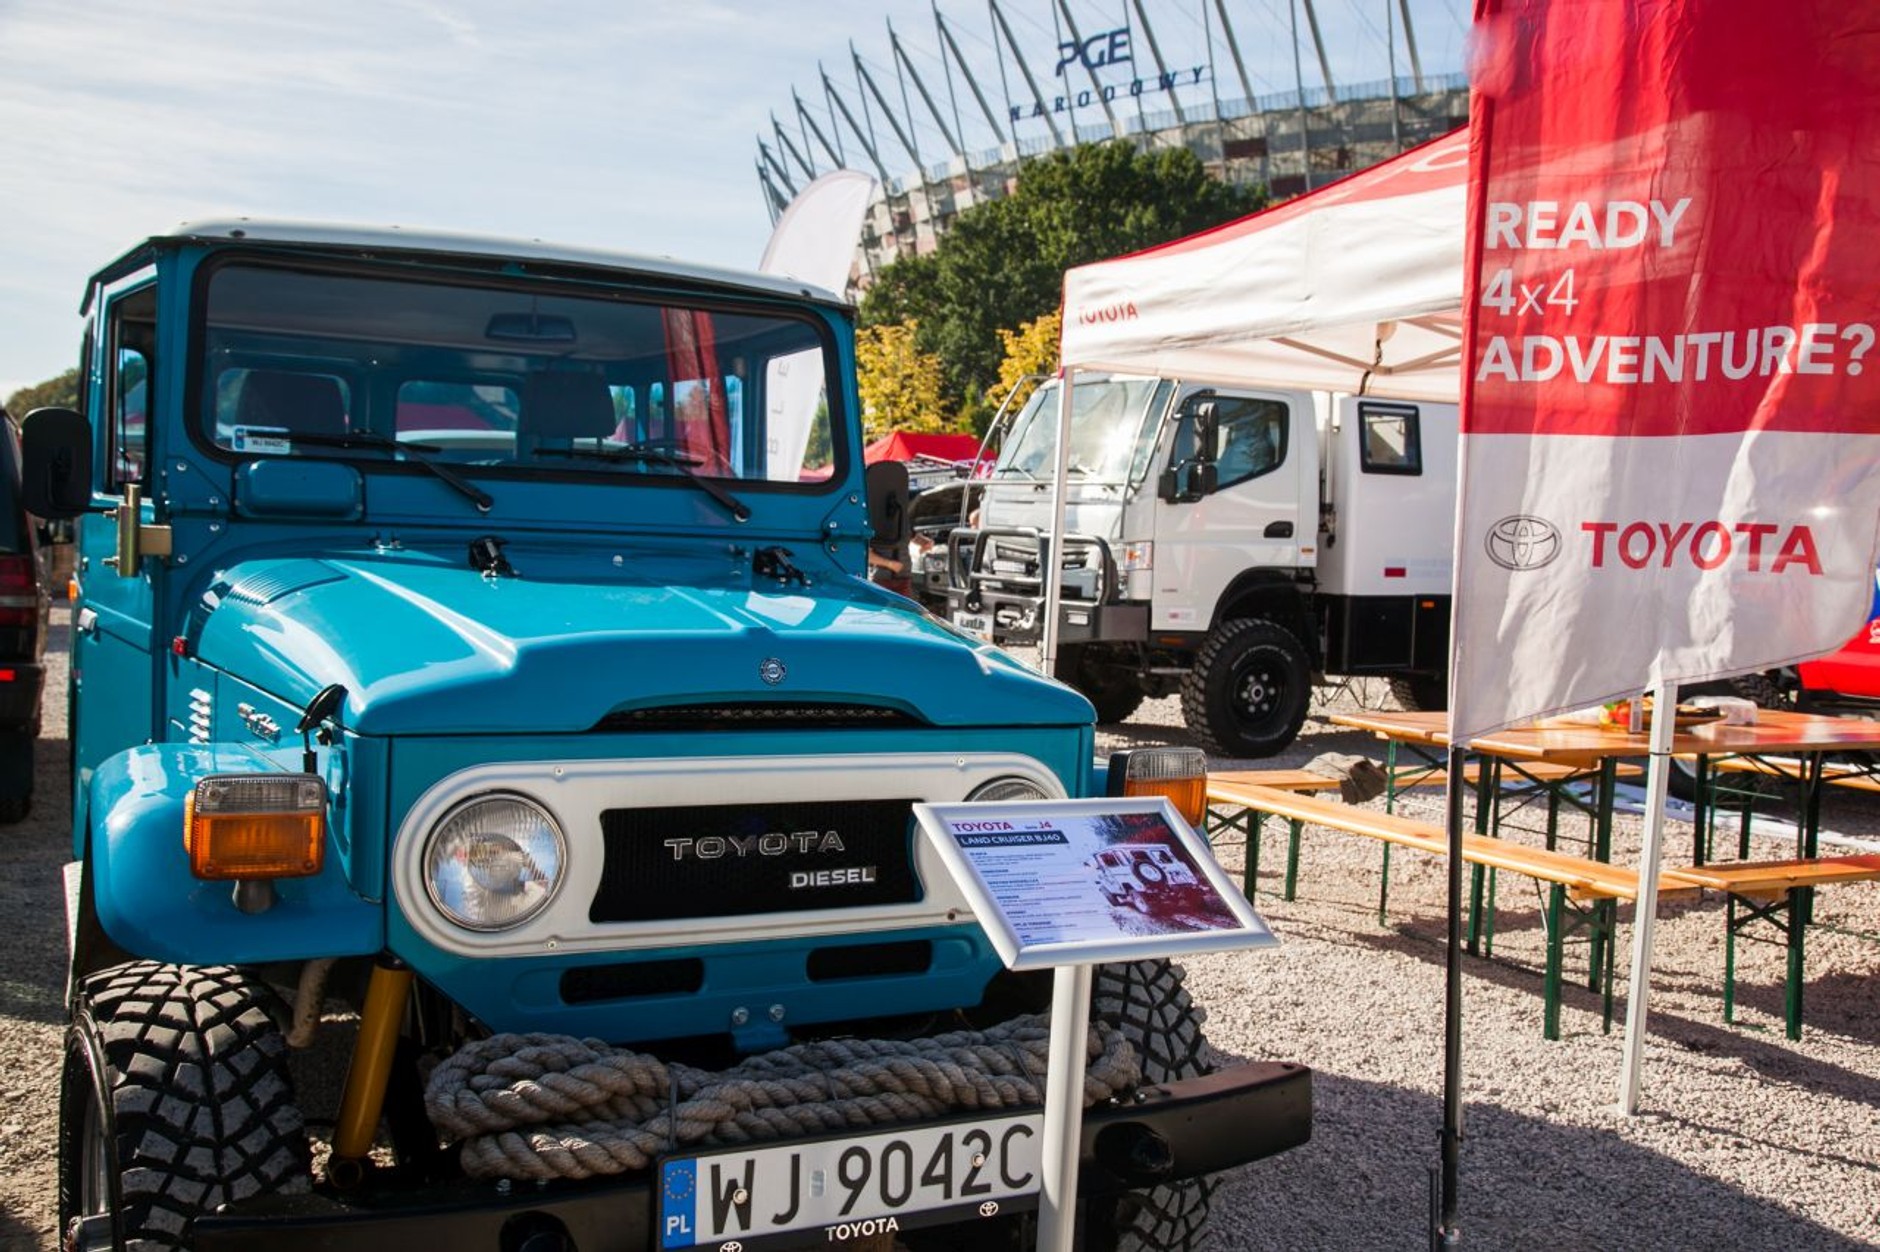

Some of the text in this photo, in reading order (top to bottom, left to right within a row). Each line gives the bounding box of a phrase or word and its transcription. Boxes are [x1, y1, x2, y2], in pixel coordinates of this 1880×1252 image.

[1056, 27, 1131, 77] PGE
[1010, 65, 1206, 121] NARODOWY
[1486, 198, 1693, 249] READY
[1480, 268, 1579, 317] 4x4
[1474, 322, 1876, 384] ADVENTURE?
[1581, 521, 1824, 575] TOYOTA
[664, 831, 845, 860] TOYOTA
[952, 821, 1014, 832] TOYOTA
[960, 836, 991, 845] LAND
[991, 834, 1034, 844] CRUISER
[791, 868, 875, 888] DIESEL
[710, 1124, 1034, 1235] WJ 9042C
[666, 1215, 691, 1236] PL
[825, 1217, 899, 1242] TOYOTA
